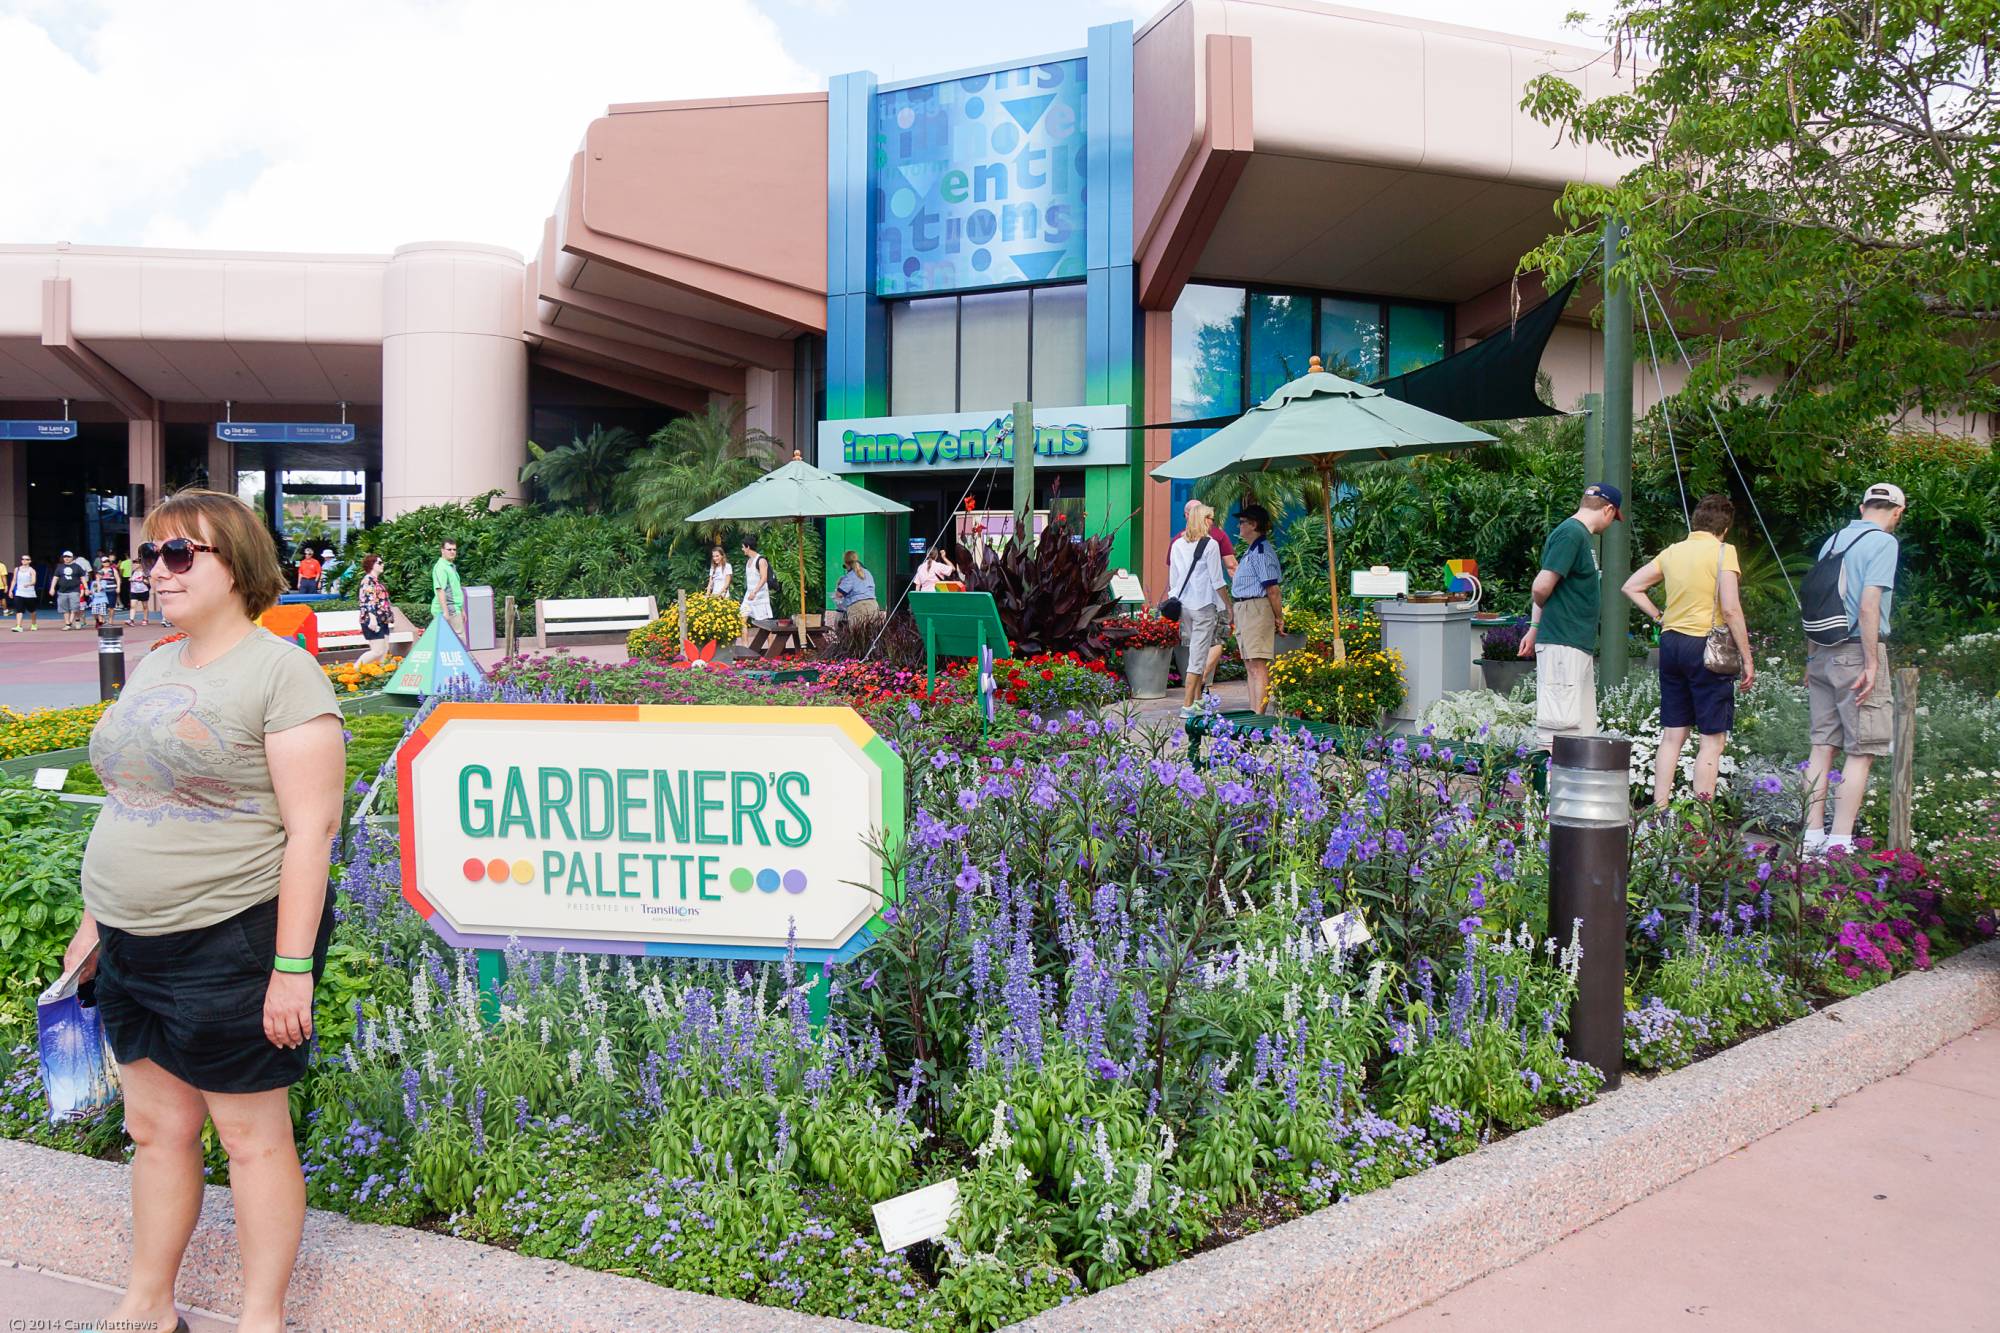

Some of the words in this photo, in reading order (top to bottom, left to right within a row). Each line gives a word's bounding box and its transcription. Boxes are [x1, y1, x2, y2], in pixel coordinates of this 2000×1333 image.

[440, 650, 462, 664] BLUE
[400, 673, 422, 688] RED
[459, 764, 812, 848] GARDENER'S
[542, 850, 721, 901] PALETTE
[567, 902, 620, 912] PRESENTED
[624, 903, 635, 912] BY
[641, 903, 700, 916] Transitions
